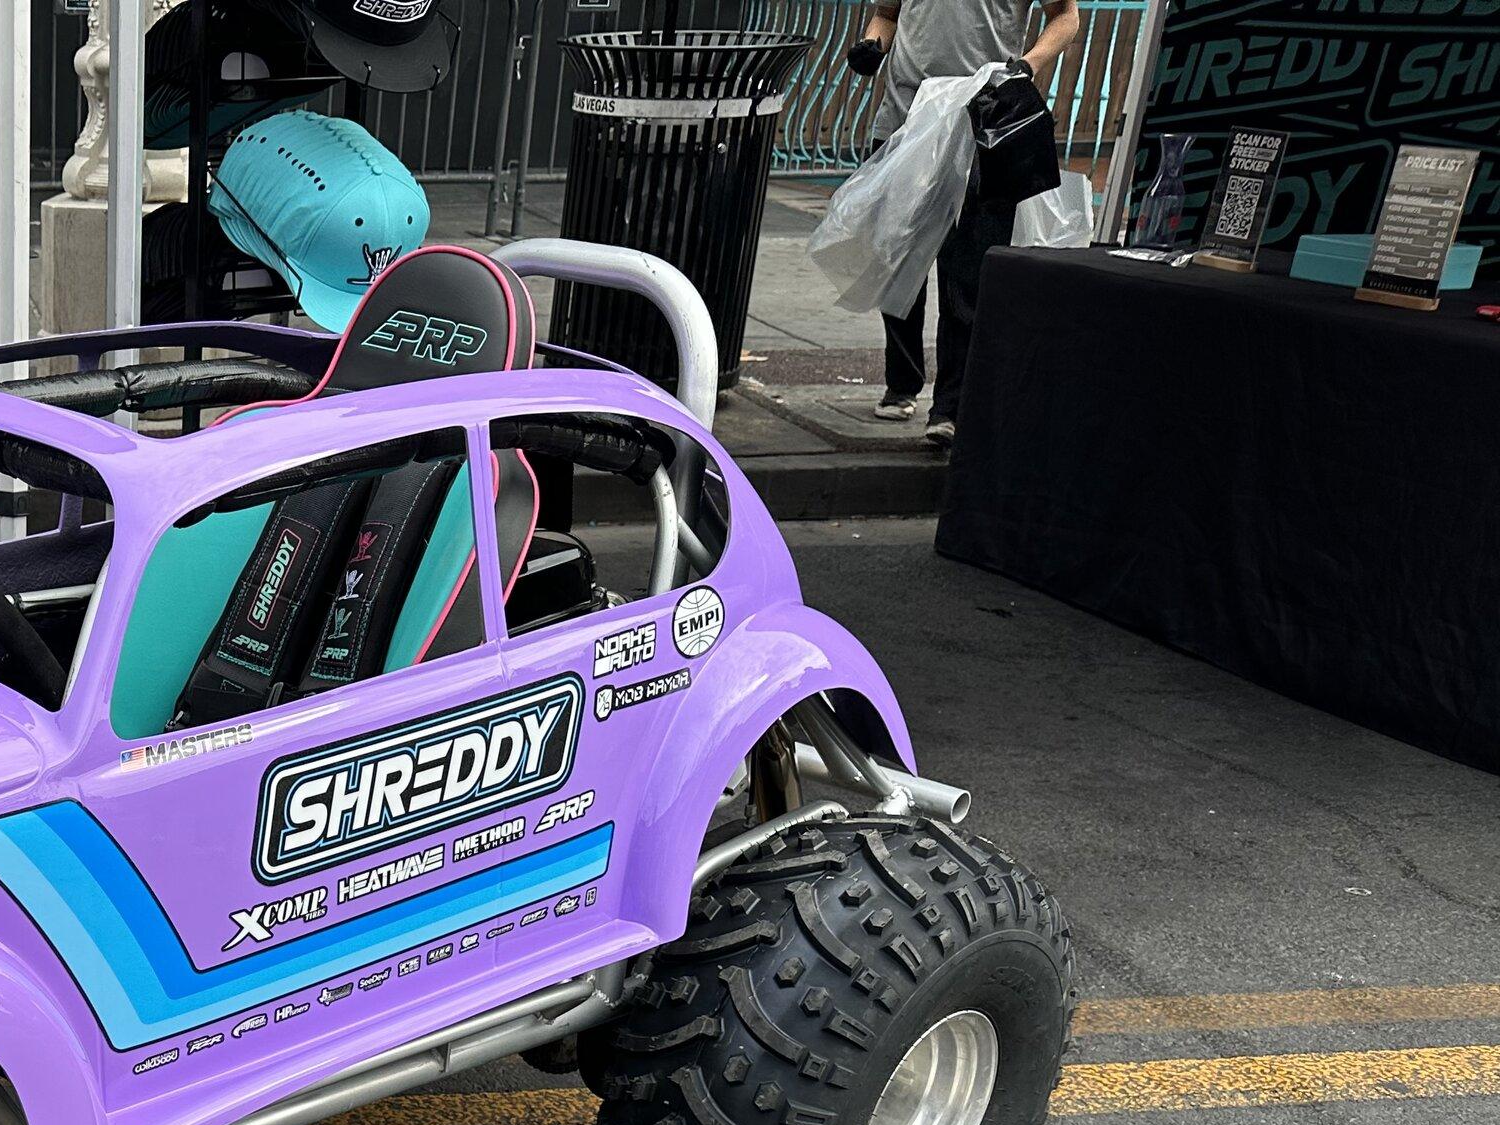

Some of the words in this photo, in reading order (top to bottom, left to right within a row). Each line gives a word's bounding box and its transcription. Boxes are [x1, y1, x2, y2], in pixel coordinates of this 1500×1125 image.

[359, 0, 434, 18] SHREDDY
[586, 98, 616, 113] VEGAS
[1234, 132, 1261, 147] SCAN
[1260, 136, 1282, 149] FOR
[1229, 157, 1271, 173] STICKER
[1405, 156, 1438, 170] PRICE
[1438, 159, 1465, 172] LIST
[361, 310, 488, 365] PRP
[252, 536, 295, 624] SHREDDY
[678, 607, 720, 638] EMPI
[232, 634, 270, 653] PRP
[321, 646, 350, 660] PRP
[595, 624, 656, 660] NOAH'S
[610, 642, 655, 673] AUTO
[614, 684, 644, 707] MOB
[646, 671, 691, 698] ARMOR
[145, 723, 253, 767] MASTERS
[284, 704, 566, 851] SHREDDY
[454, 818, 525, 856] METHOD
[535, 791, 594, 833] PRP
[454, 847, 479, 861] RACE
[483, 831, 524, 850] WHEELS
[338, 845, 444, 904] HEATWAVE
[305, 907, 327, 922] TIRES
